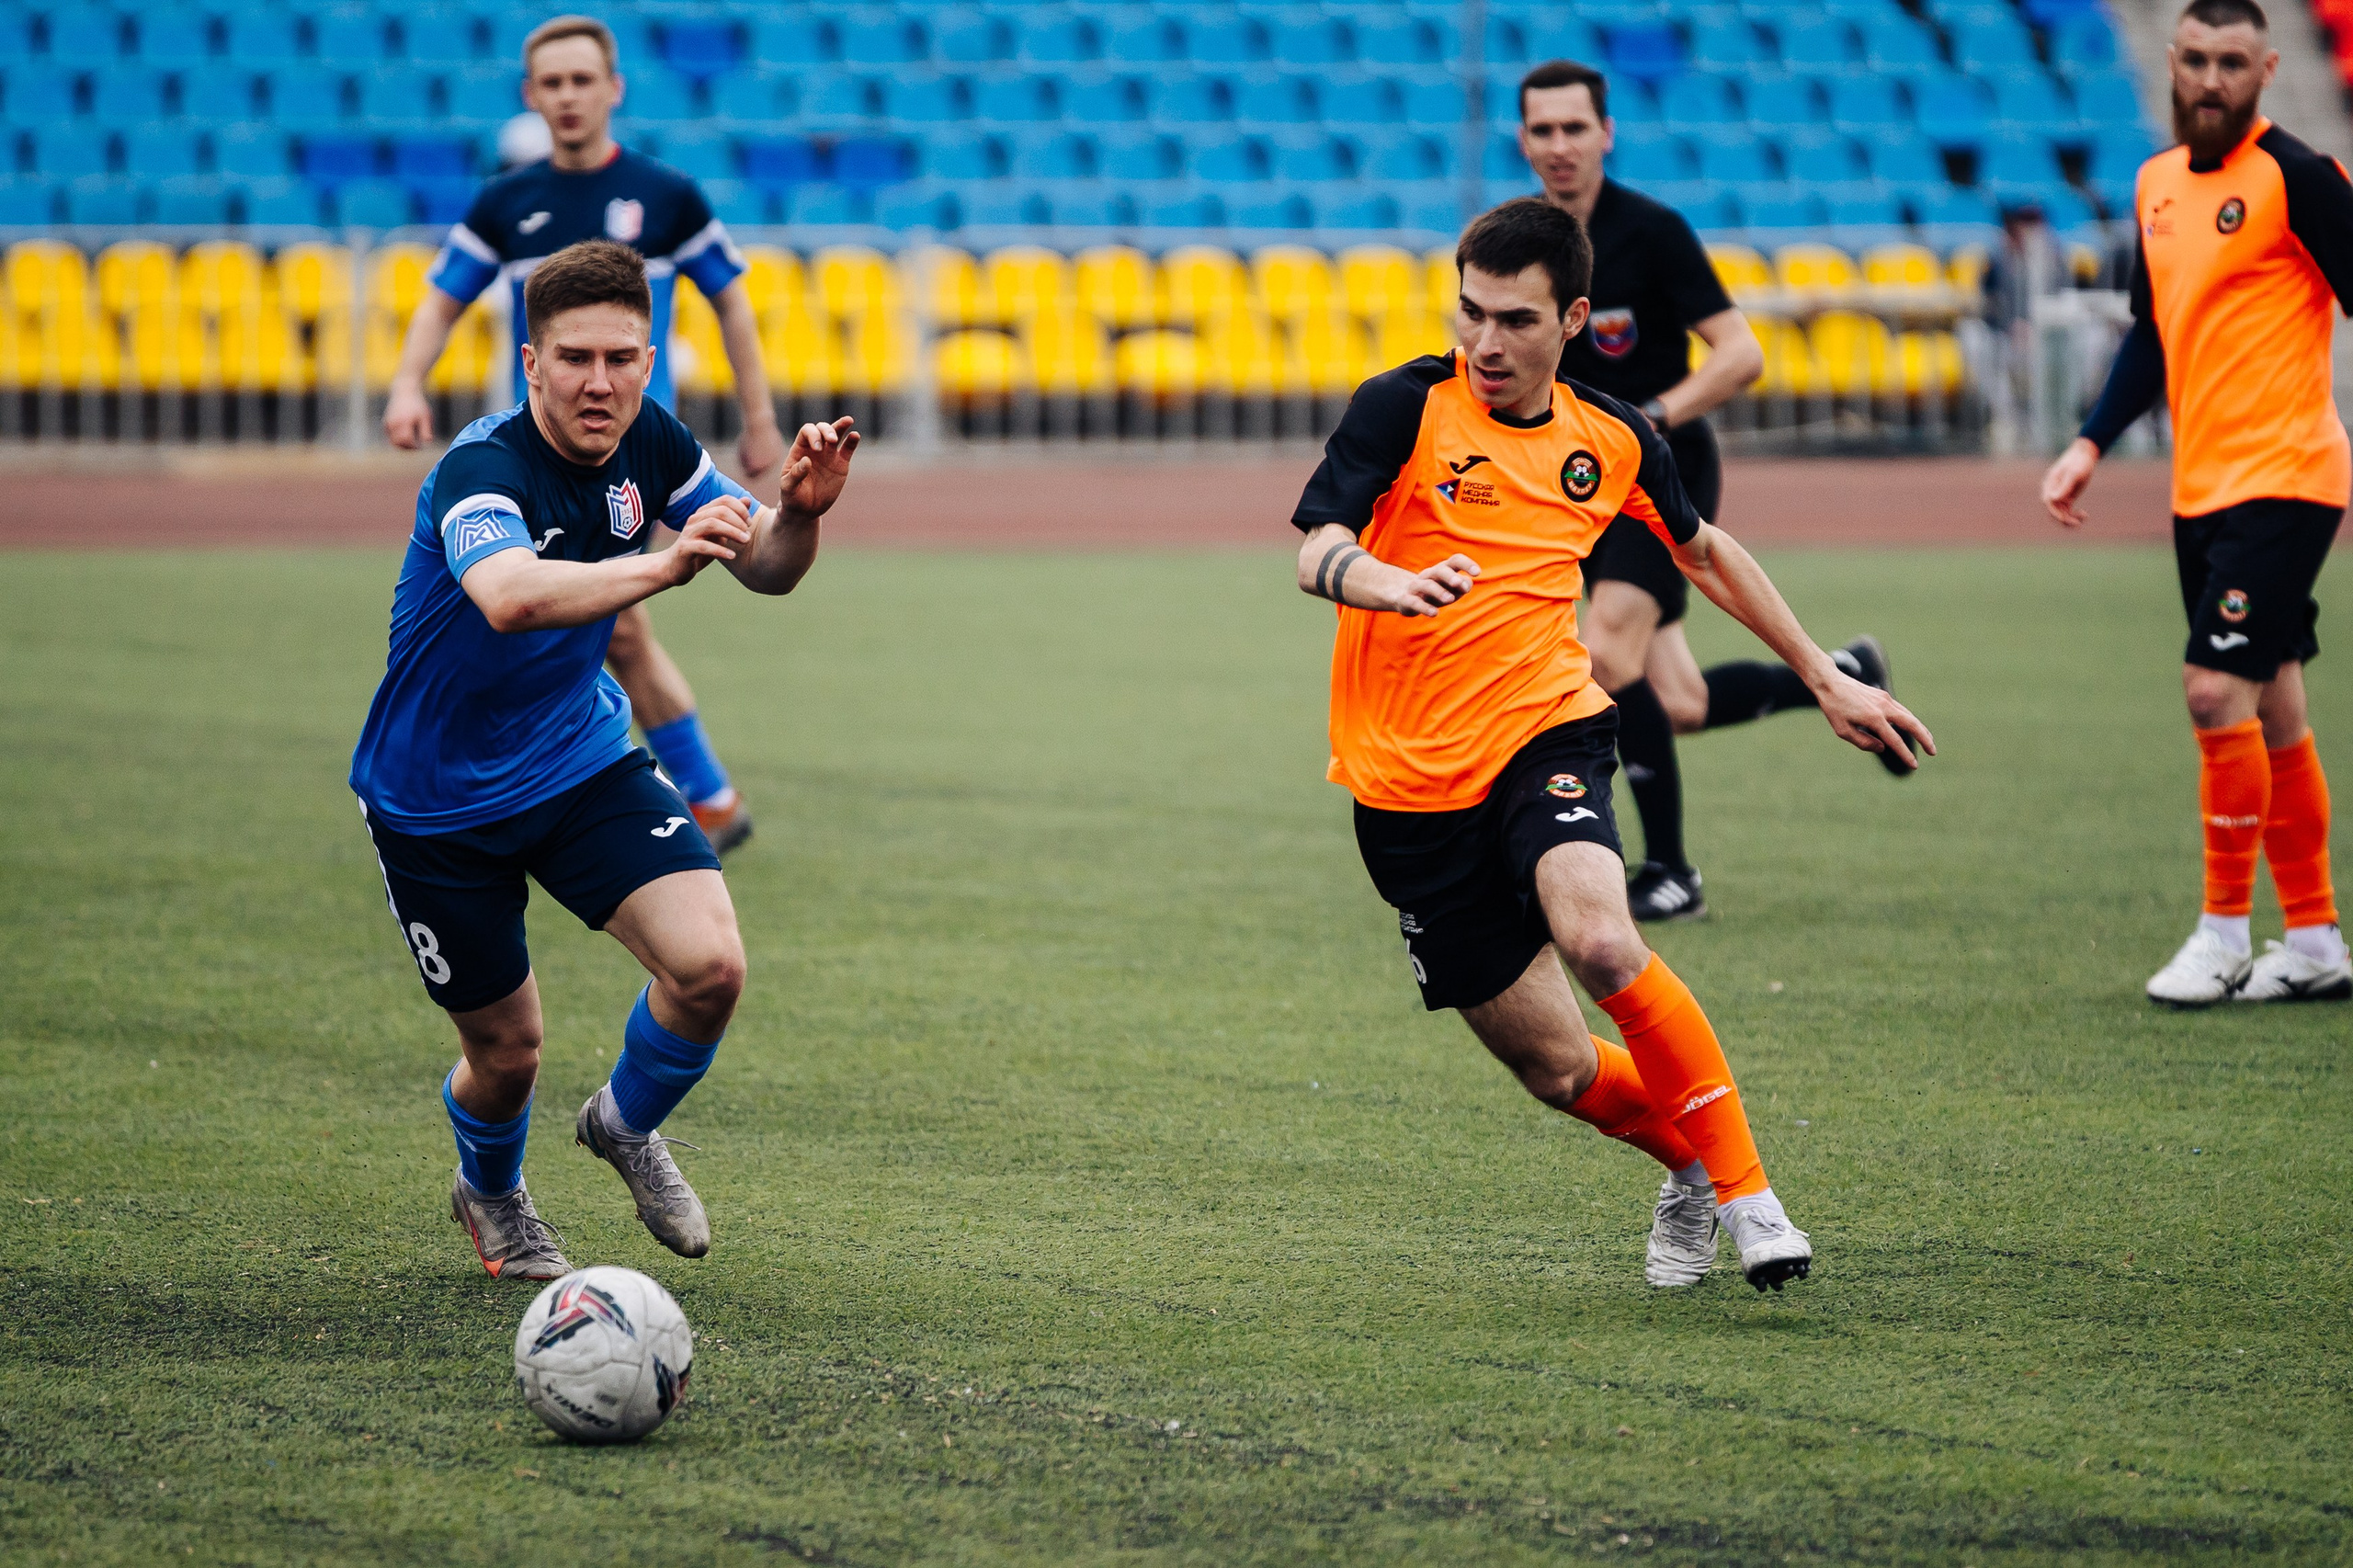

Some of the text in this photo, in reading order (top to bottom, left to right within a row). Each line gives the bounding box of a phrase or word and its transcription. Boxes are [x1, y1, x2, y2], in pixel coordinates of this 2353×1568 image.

[1464, 481, 1495, 491] РУССКАЯ
[1462, 489, 1493, 498] МЕДНАЯ
[1461, 496, 1500, 506] КОМПАНИЯ
[409, 922, 451, 984] 8
[1682, 1085, 1732, 1114] JÖGEL
